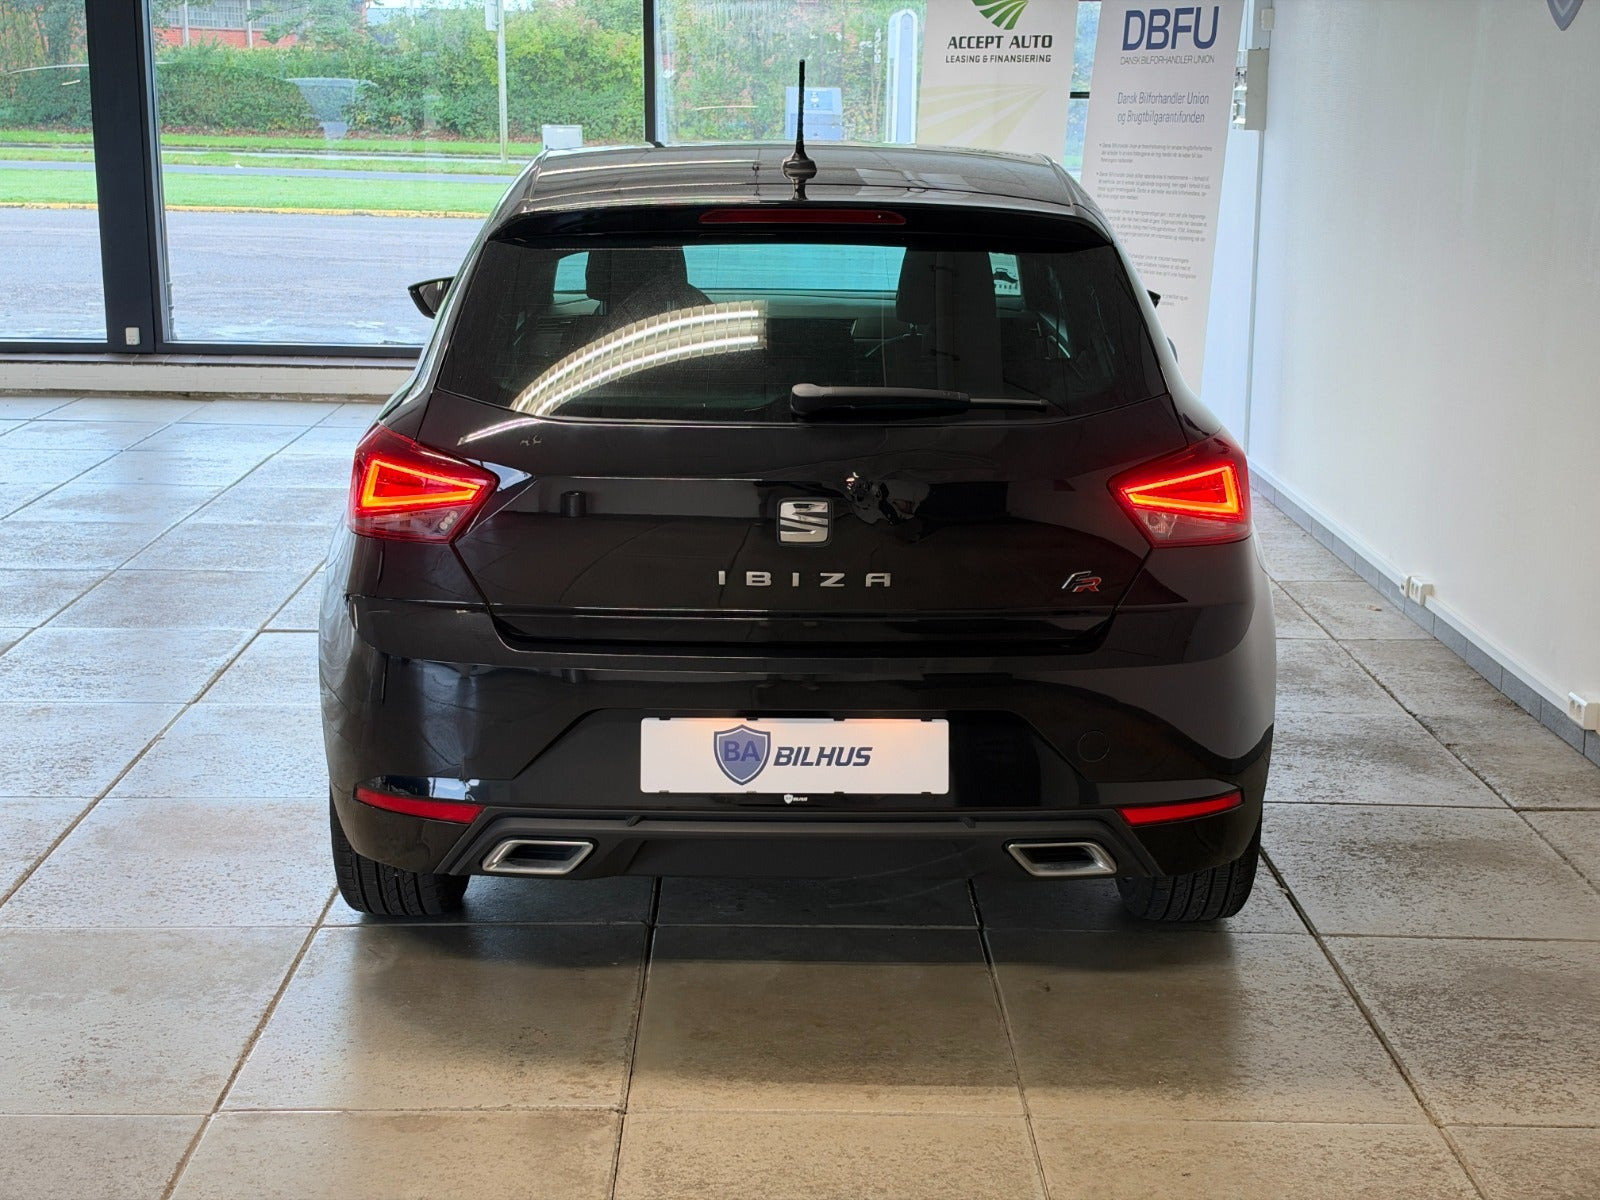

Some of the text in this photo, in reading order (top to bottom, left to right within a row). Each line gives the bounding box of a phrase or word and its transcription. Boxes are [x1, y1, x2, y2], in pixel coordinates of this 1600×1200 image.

[1122, 6, 1219, 51] DBFU
[947, 35, 1053, 49] ACCEPT AUTO
[945, 54, 1052, 63] LEASING & FINANSIERING
[1120, 54, 1215, 65] DANSK BILFORHANDLER UNION
[1117, 92, 1210, 104] Dansk Bilforhandler Union
[1117, 110, 1205, 125] og Brugtbilgarantifonden
[717, 570, 891, 588] IBIZA
[1061, 570, 1102, 593] FR
[723, 740, 873, 767] BA BILHUS
